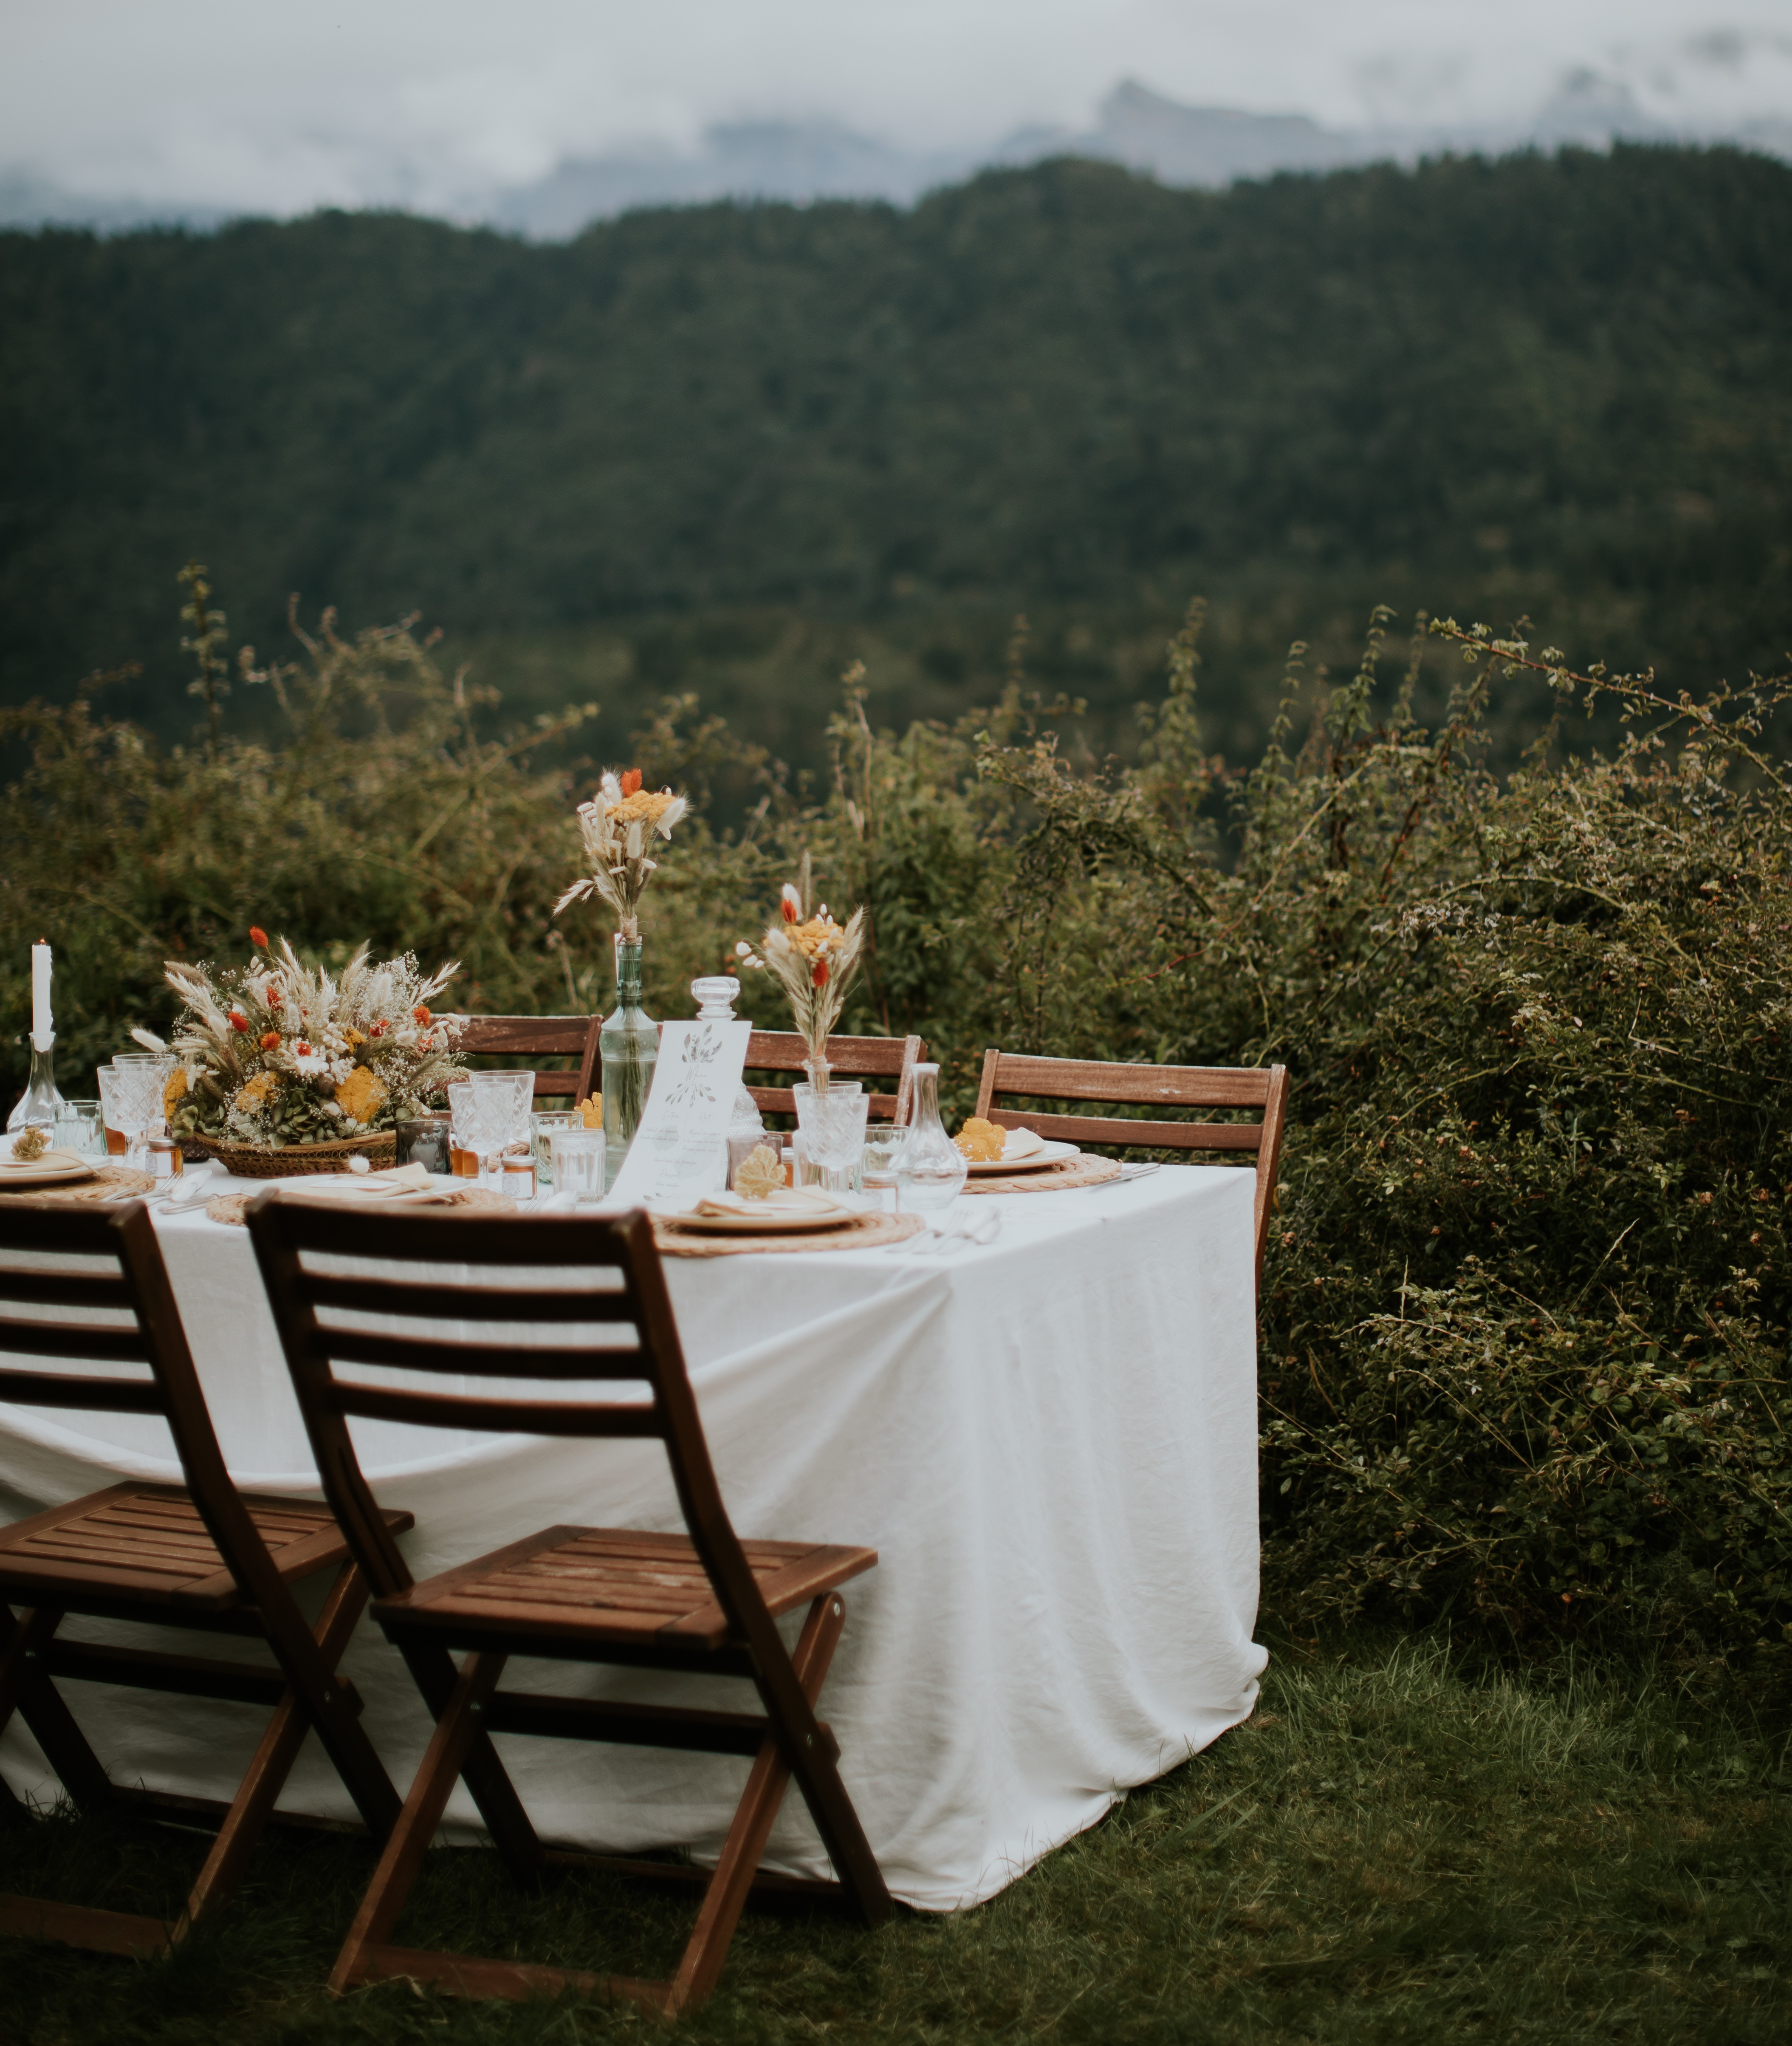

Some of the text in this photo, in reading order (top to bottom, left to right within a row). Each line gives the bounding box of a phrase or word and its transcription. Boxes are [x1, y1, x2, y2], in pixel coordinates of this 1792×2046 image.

[686, 1064, 707, 1083] Menu
[699, 1111, 712, 1123] Plat
[658, 1169, 681, 1179] Dessert
